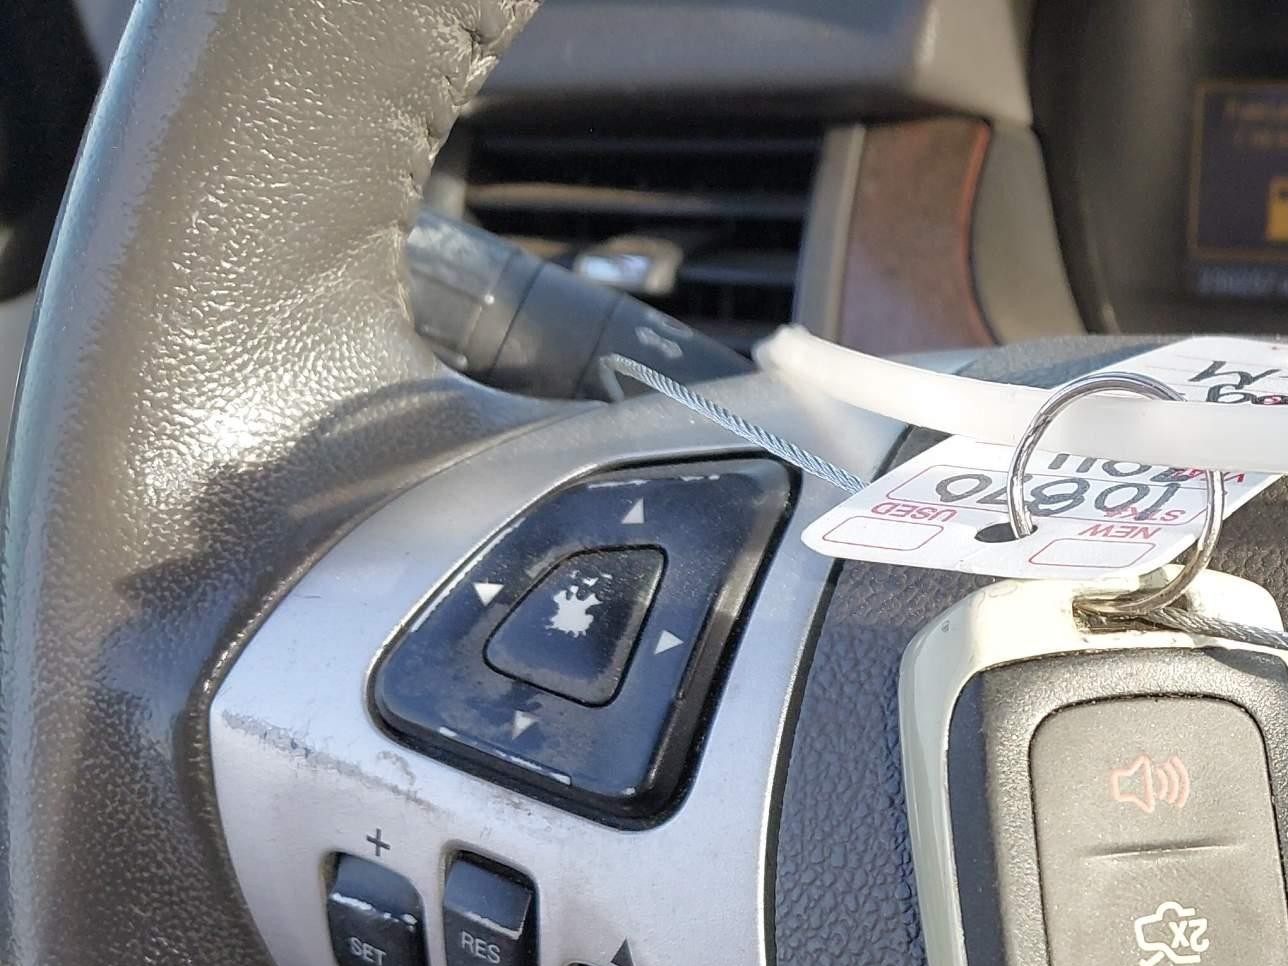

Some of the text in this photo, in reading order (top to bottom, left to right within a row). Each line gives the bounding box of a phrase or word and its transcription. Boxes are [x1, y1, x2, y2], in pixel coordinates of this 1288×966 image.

[870, 501, 958, 523] USED
[1078, 524, 1162, 541] NEW
[349, 937, 386, 966] SET
[461, 930, 500, 964] RES
